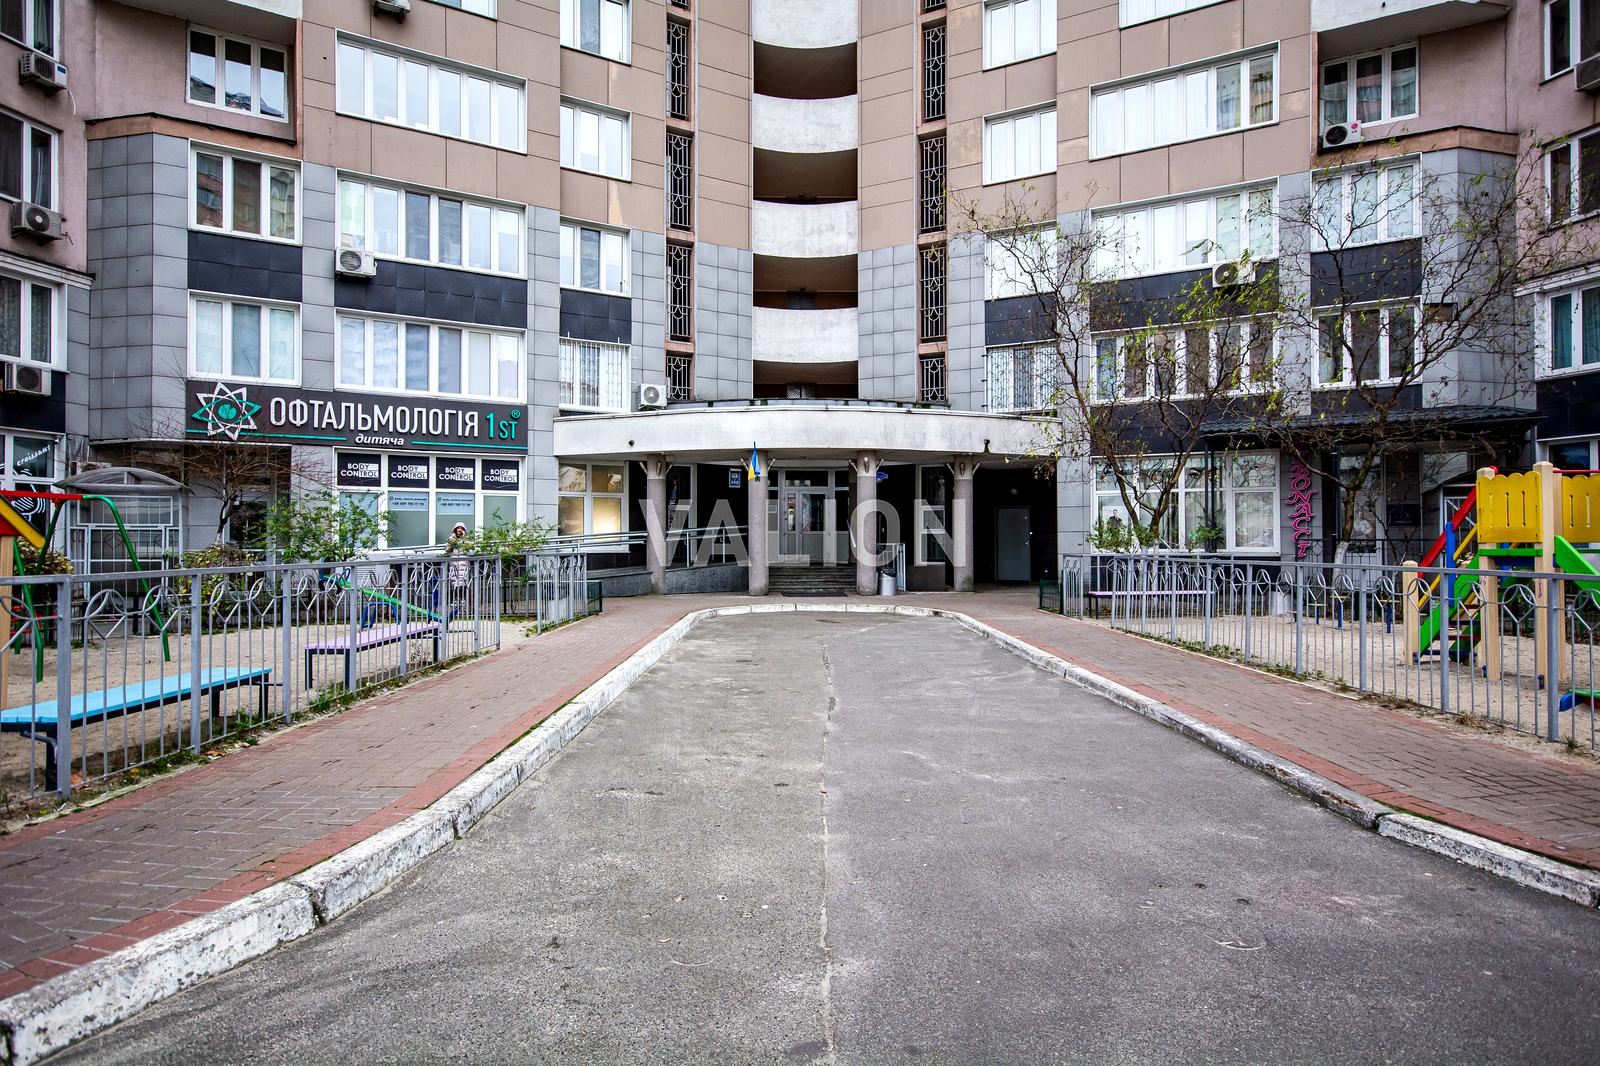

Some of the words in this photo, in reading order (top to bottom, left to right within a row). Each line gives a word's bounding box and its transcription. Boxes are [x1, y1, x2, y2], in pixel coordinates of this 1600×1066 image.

[270, 397, 479, 437] ОФТАЛЬМОЛОГІЯ
[355, 433, 405, 446] дитяча
[16, 444, 51, 467] croissant
[340, 469, 377, 477] CONTROL
[391, 471, 426, 479] CONTROL
[438, 473, 472, 481] CONTROL
